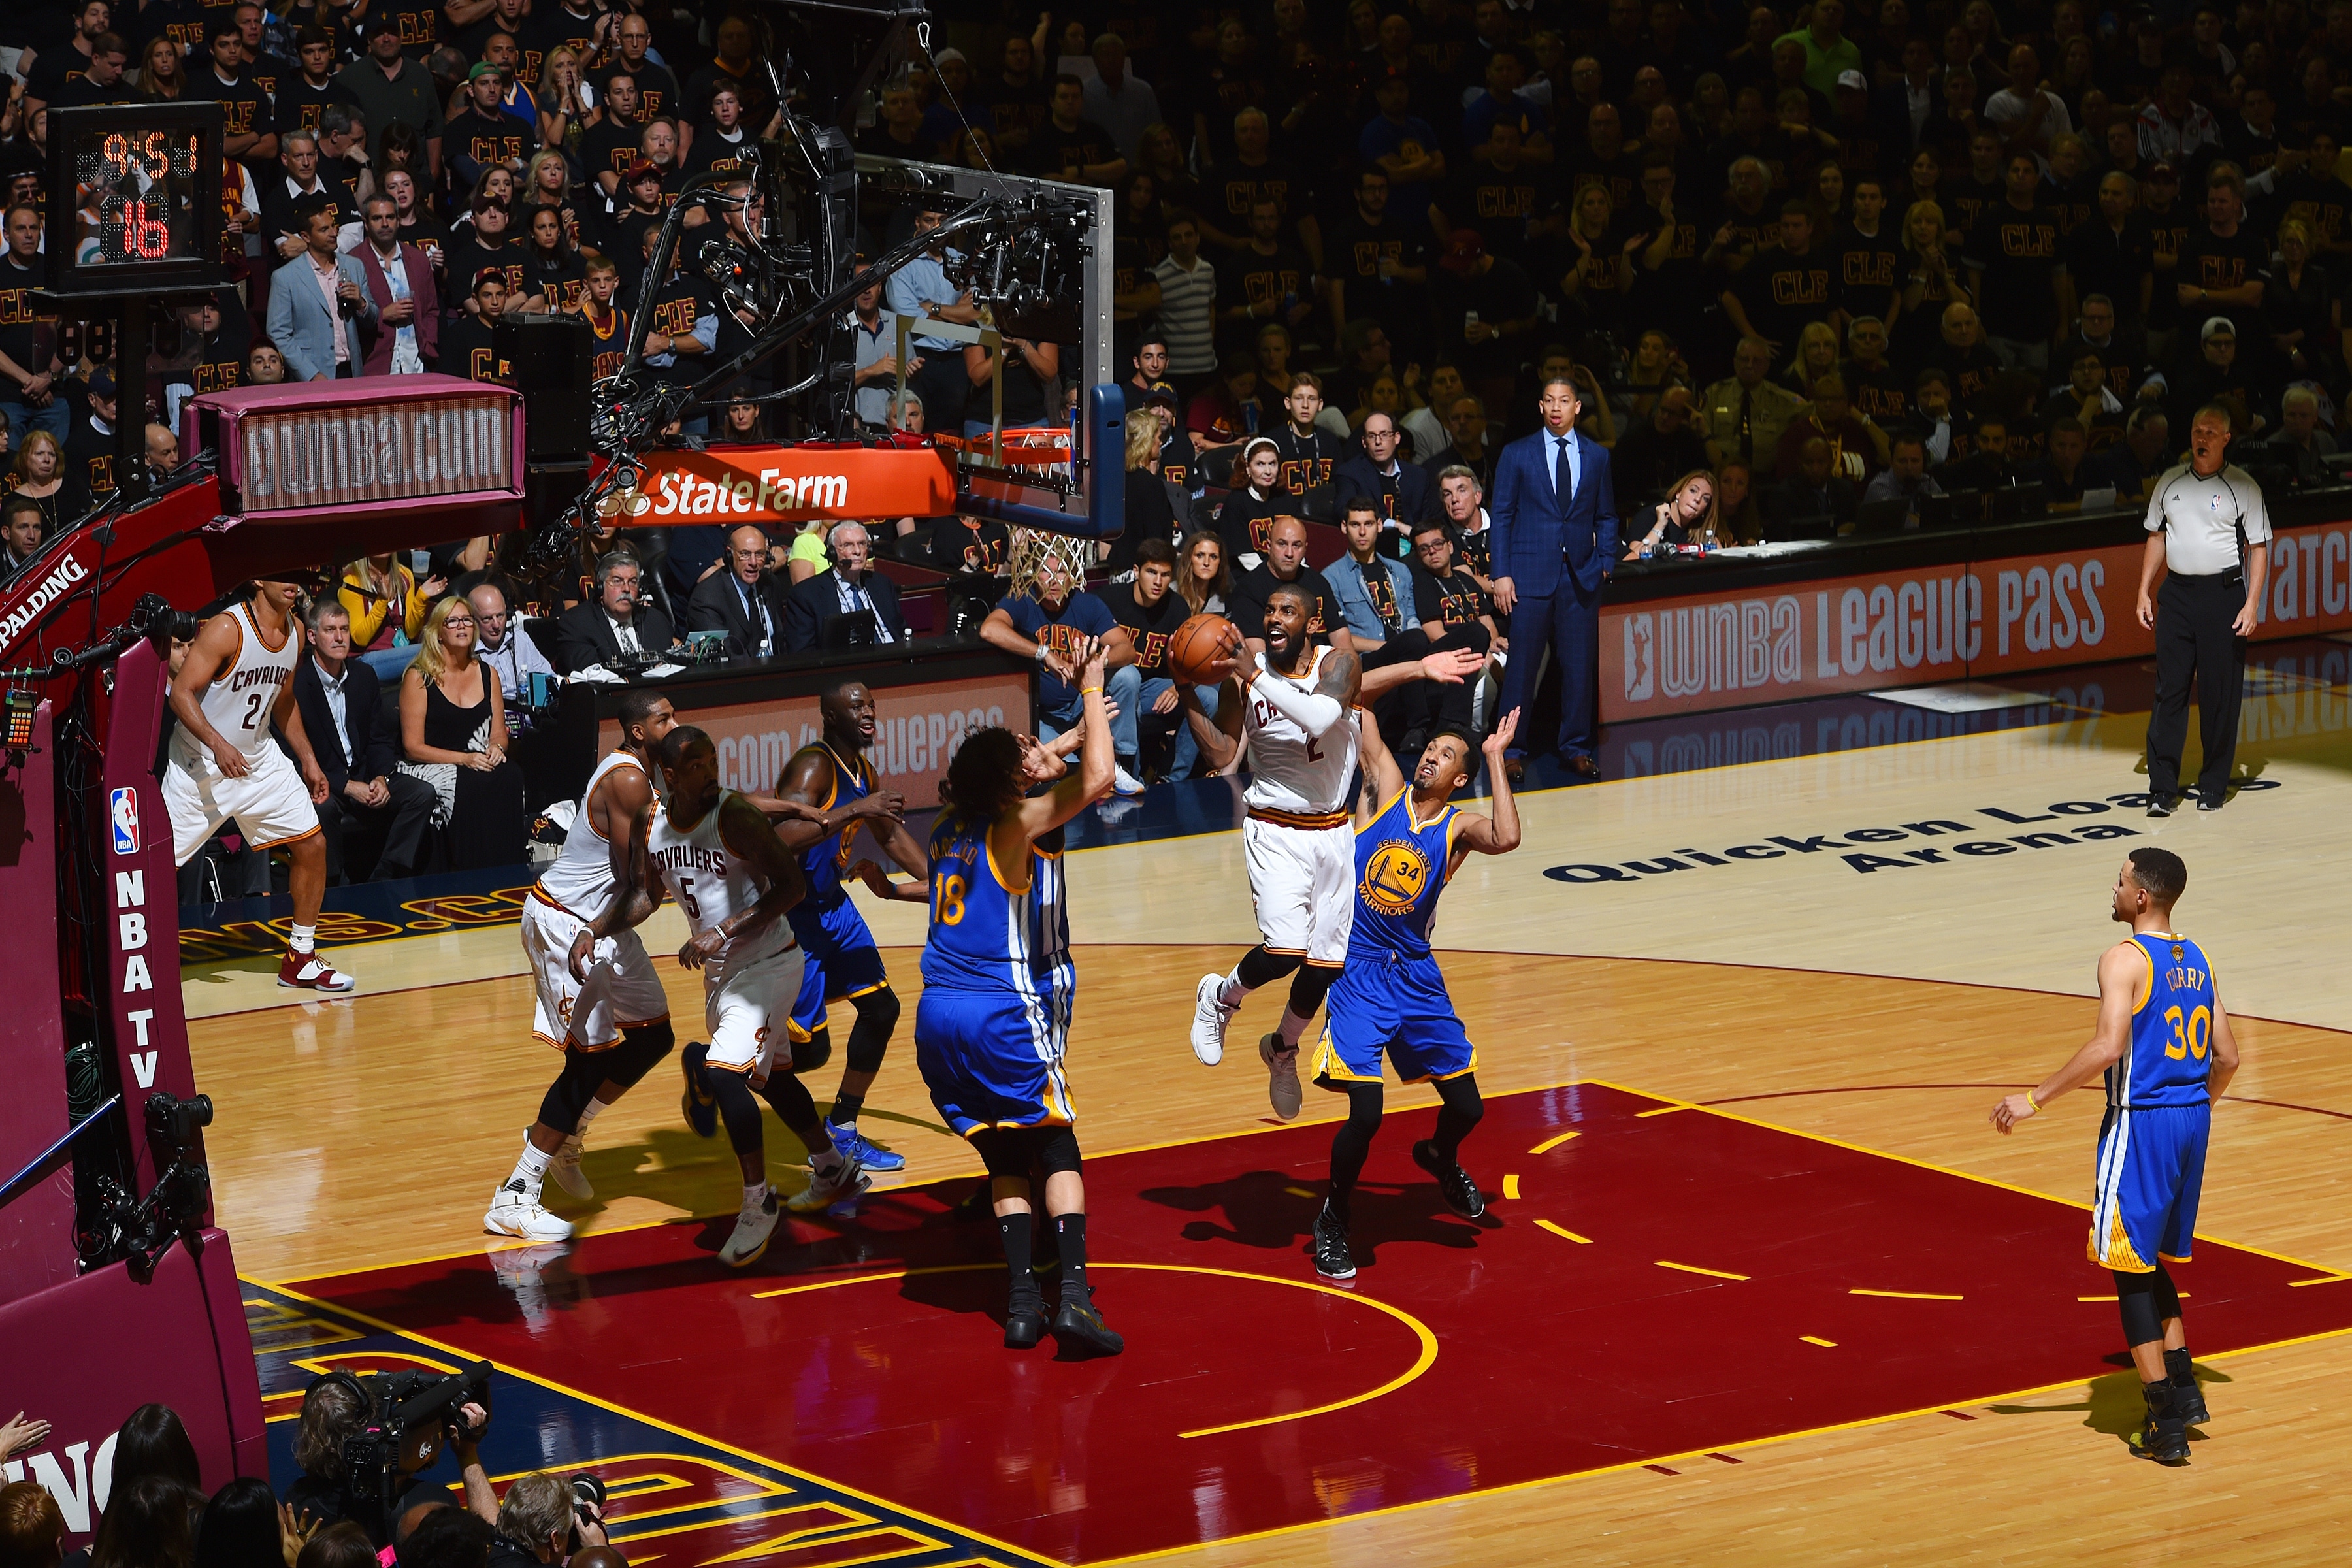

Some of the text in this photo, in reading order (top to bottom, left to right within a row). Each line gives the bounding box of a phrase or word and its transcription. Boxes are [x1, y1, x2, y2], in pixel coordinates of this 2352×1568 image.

[215, 99, 257, 135] LE
[103, 131, 197, 180] 9:51
[470, 136, 522, 165] CLE
[1477, 186, 1535, 218] CLE
[124, 199, 169, 259] 16
[2001, 223, 2055, 257] CLE
[1843, 250, 1896, 286] CLE
[1244, 270, 1300, 305] CLE
[1772, 269, 1828, 305] CLE
[654, 297, 697, 336] CLE
[1281, 458, 1333, 495] CLE
[0, 553, 84, 654] PALDING
[116, 840, 132, 850] NBA
[1542, 780, 2282, 883] Quicken Loas
[1839, 823, 2143, 874] Arena
[650, 845, 727, 880] CAVALIERS
[1377, 838, 1433, 873] GOLDEN STATE
[1396, 861, 1420, 882] 34
[679, 877, 701, 920] 5
[934, 872, 966, 926] 18
[1357, 881, 1415, 916] WARRIORS
[116, 870, 158, 1090] NBA TV
[2165, 967, 2206, 992] CURRY
[2164, 1005, 2211, 1061] 30
[419, 1442, 433, 1460] abc
